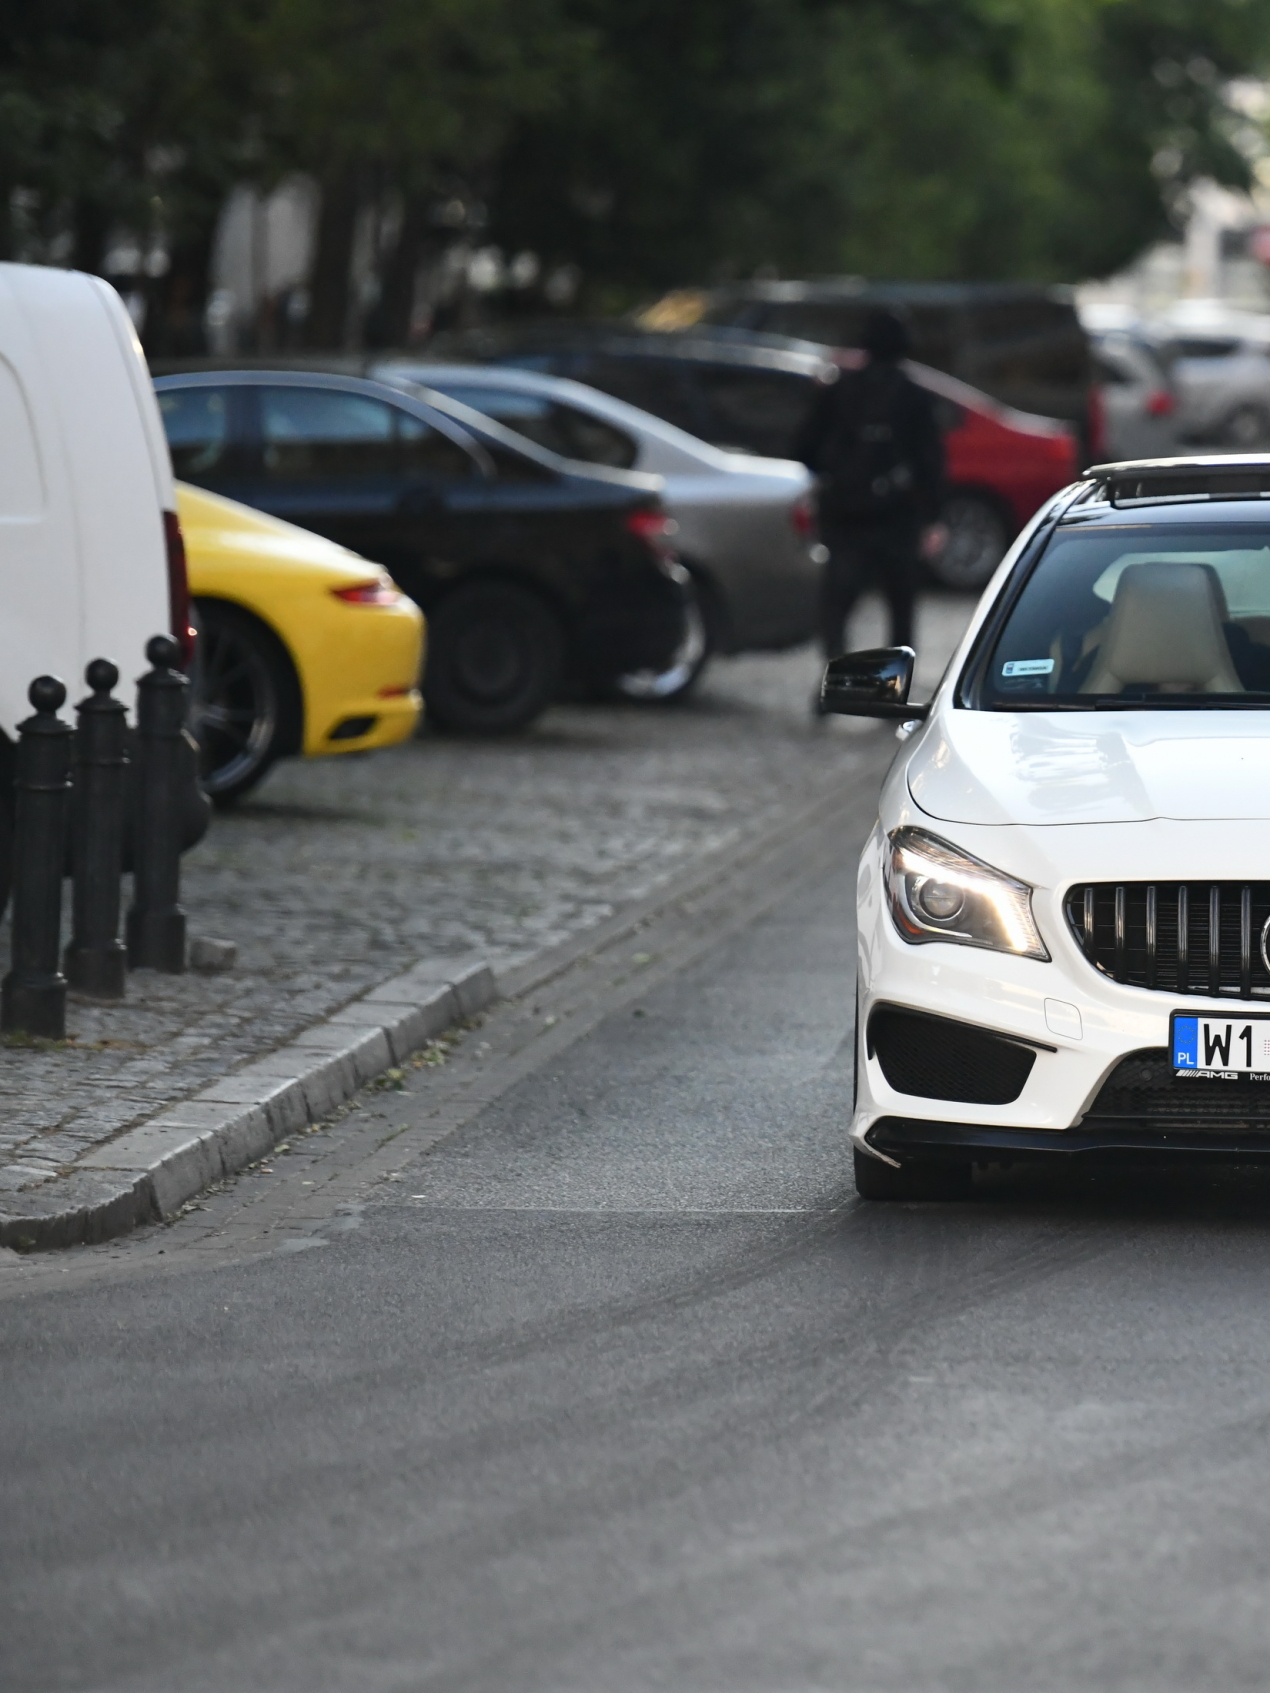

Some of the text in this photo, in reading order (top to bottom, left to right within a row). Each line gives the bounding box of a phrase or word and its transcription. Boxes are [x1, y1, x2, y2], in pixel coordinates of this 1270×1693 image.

[1203, 1023, 1253, 1068] W1
[1177, 1052, 1195, 1065] PL
[1195, 1070, 1238, 1080] AMG
